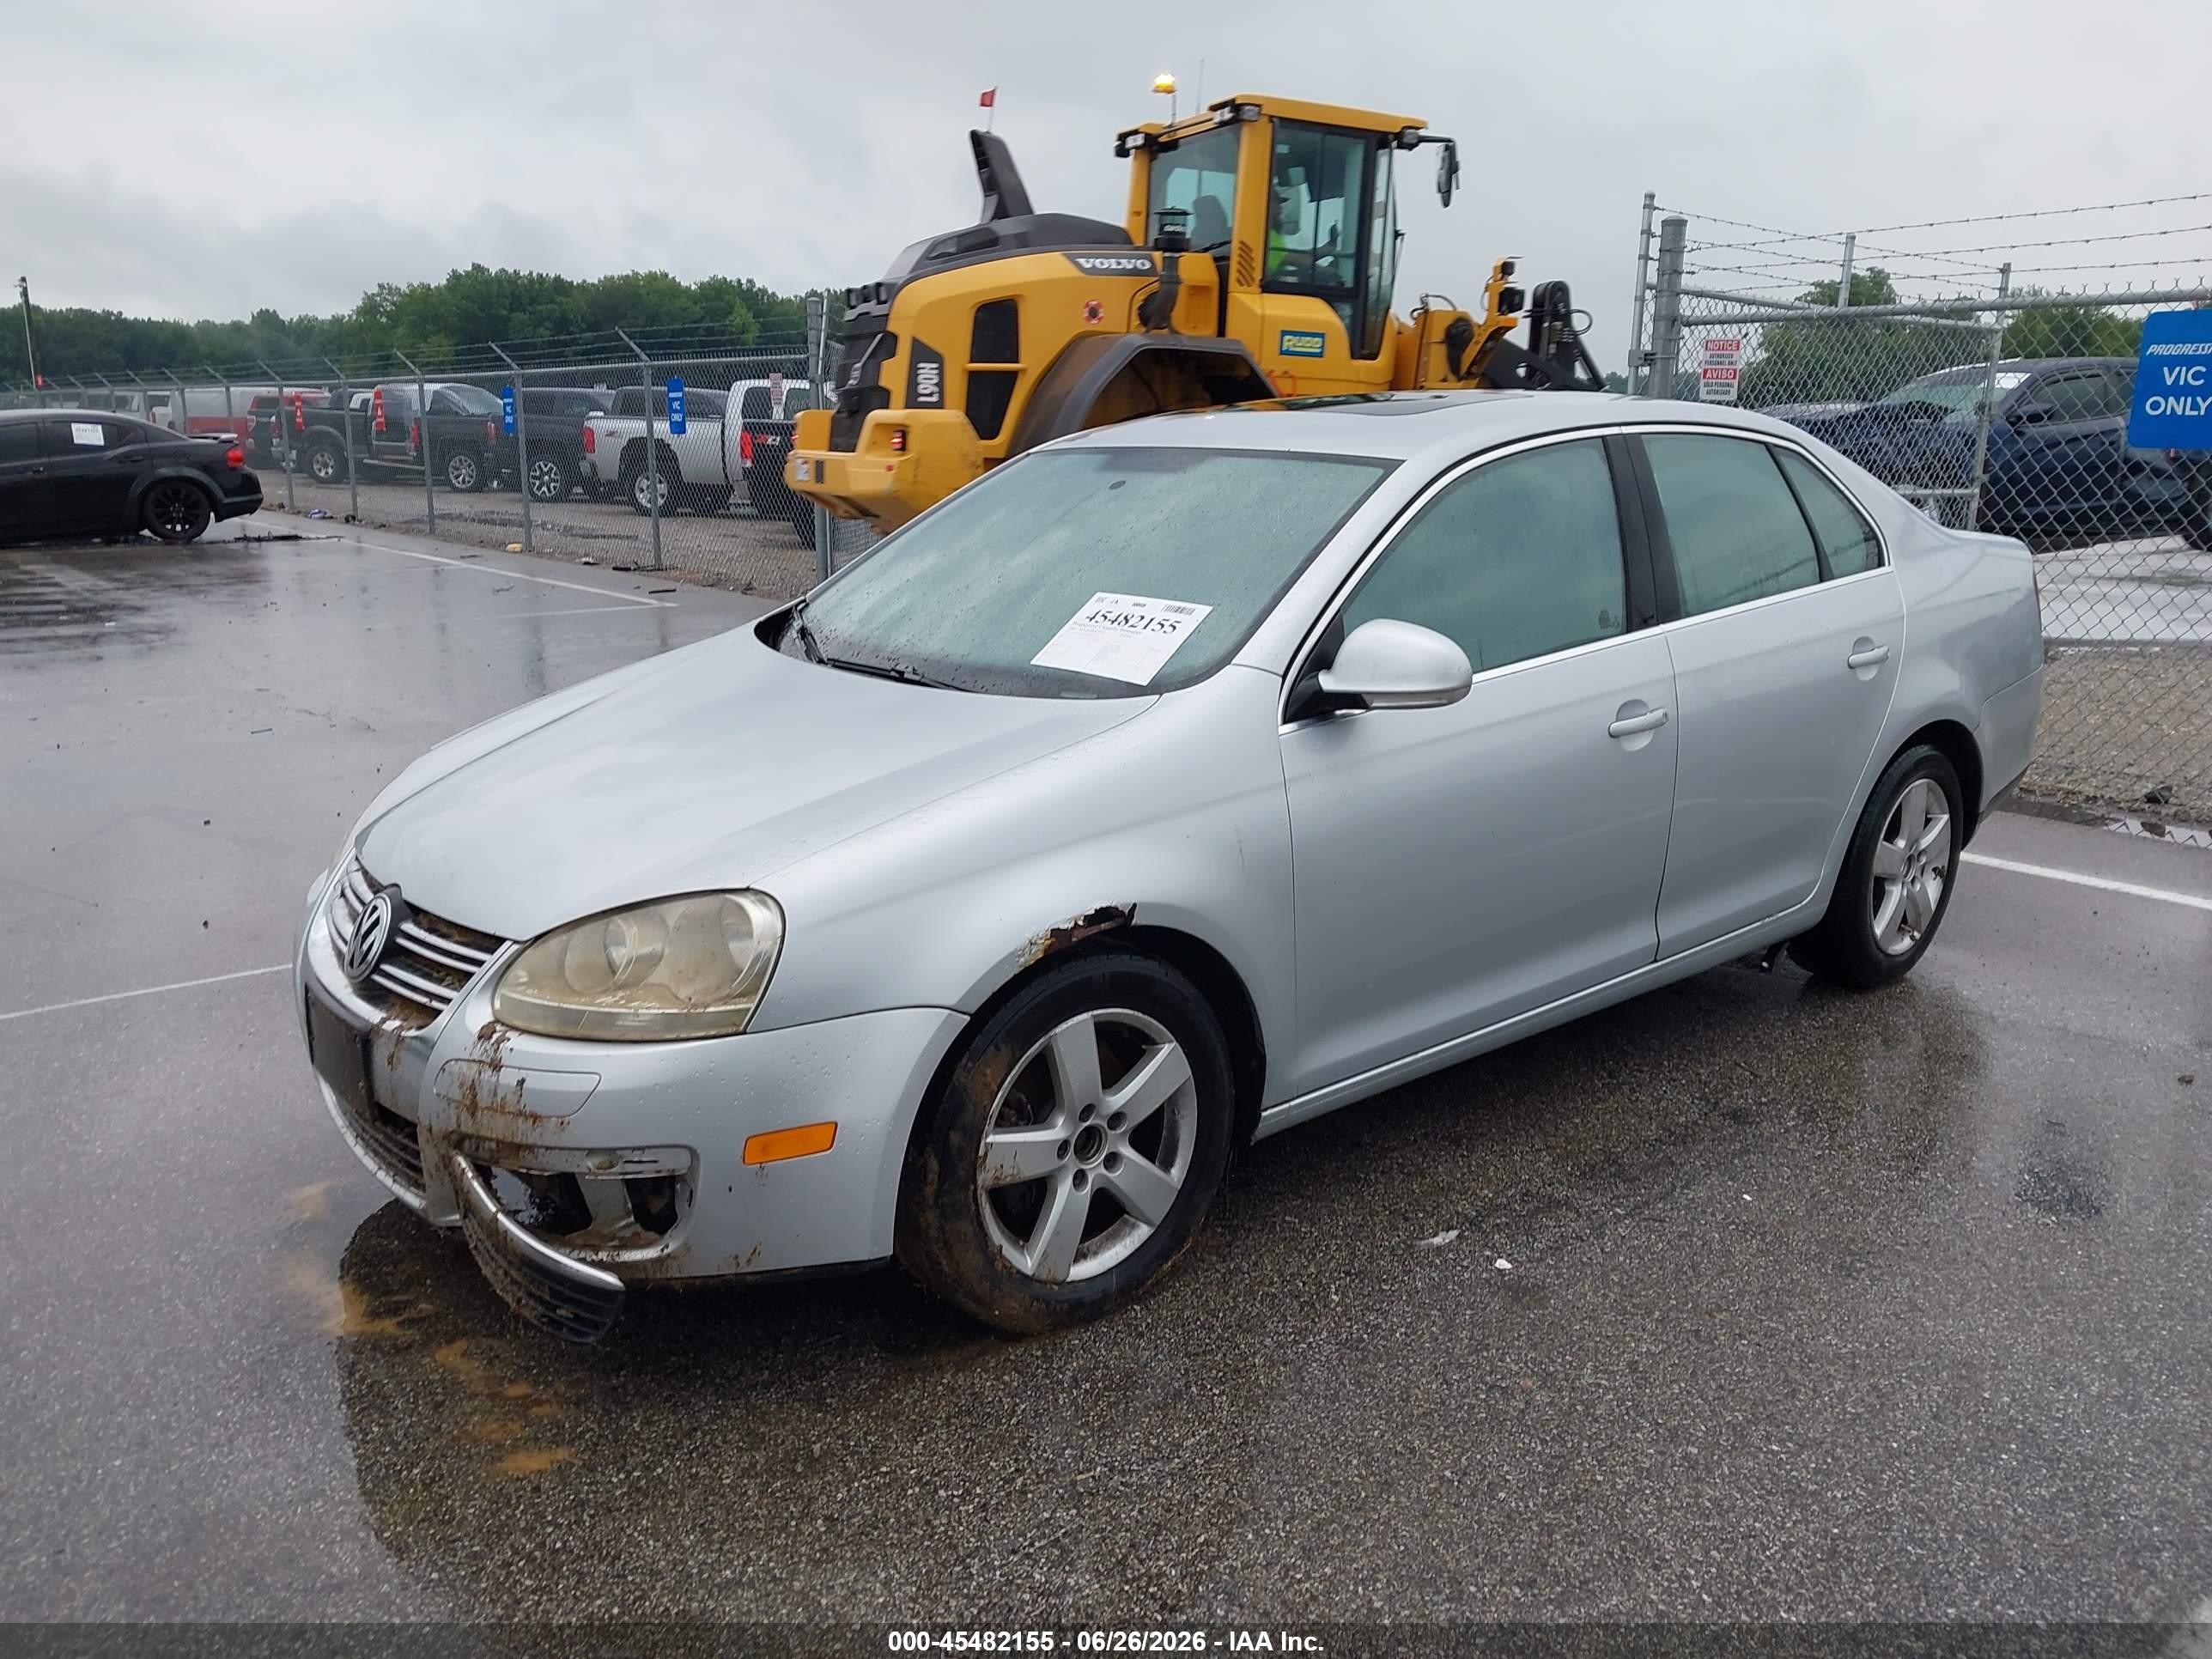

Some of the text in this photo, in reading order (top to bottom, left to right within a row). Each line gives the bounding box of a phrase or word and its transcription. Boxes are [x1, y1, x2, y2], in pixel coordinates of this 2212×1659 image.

[1075, 258, 1152, 270] VOLVO
[1707, 341, 1738, 350] NOTICE
[916, 362, 939, 403] L90H
[1705, 369, 1735, 379] AVISO
[2163, 366, 2207, 386] VIC
[2145, 396, 2212, 416] ONLY
[1085, 610, 1182, 635] 45482155
